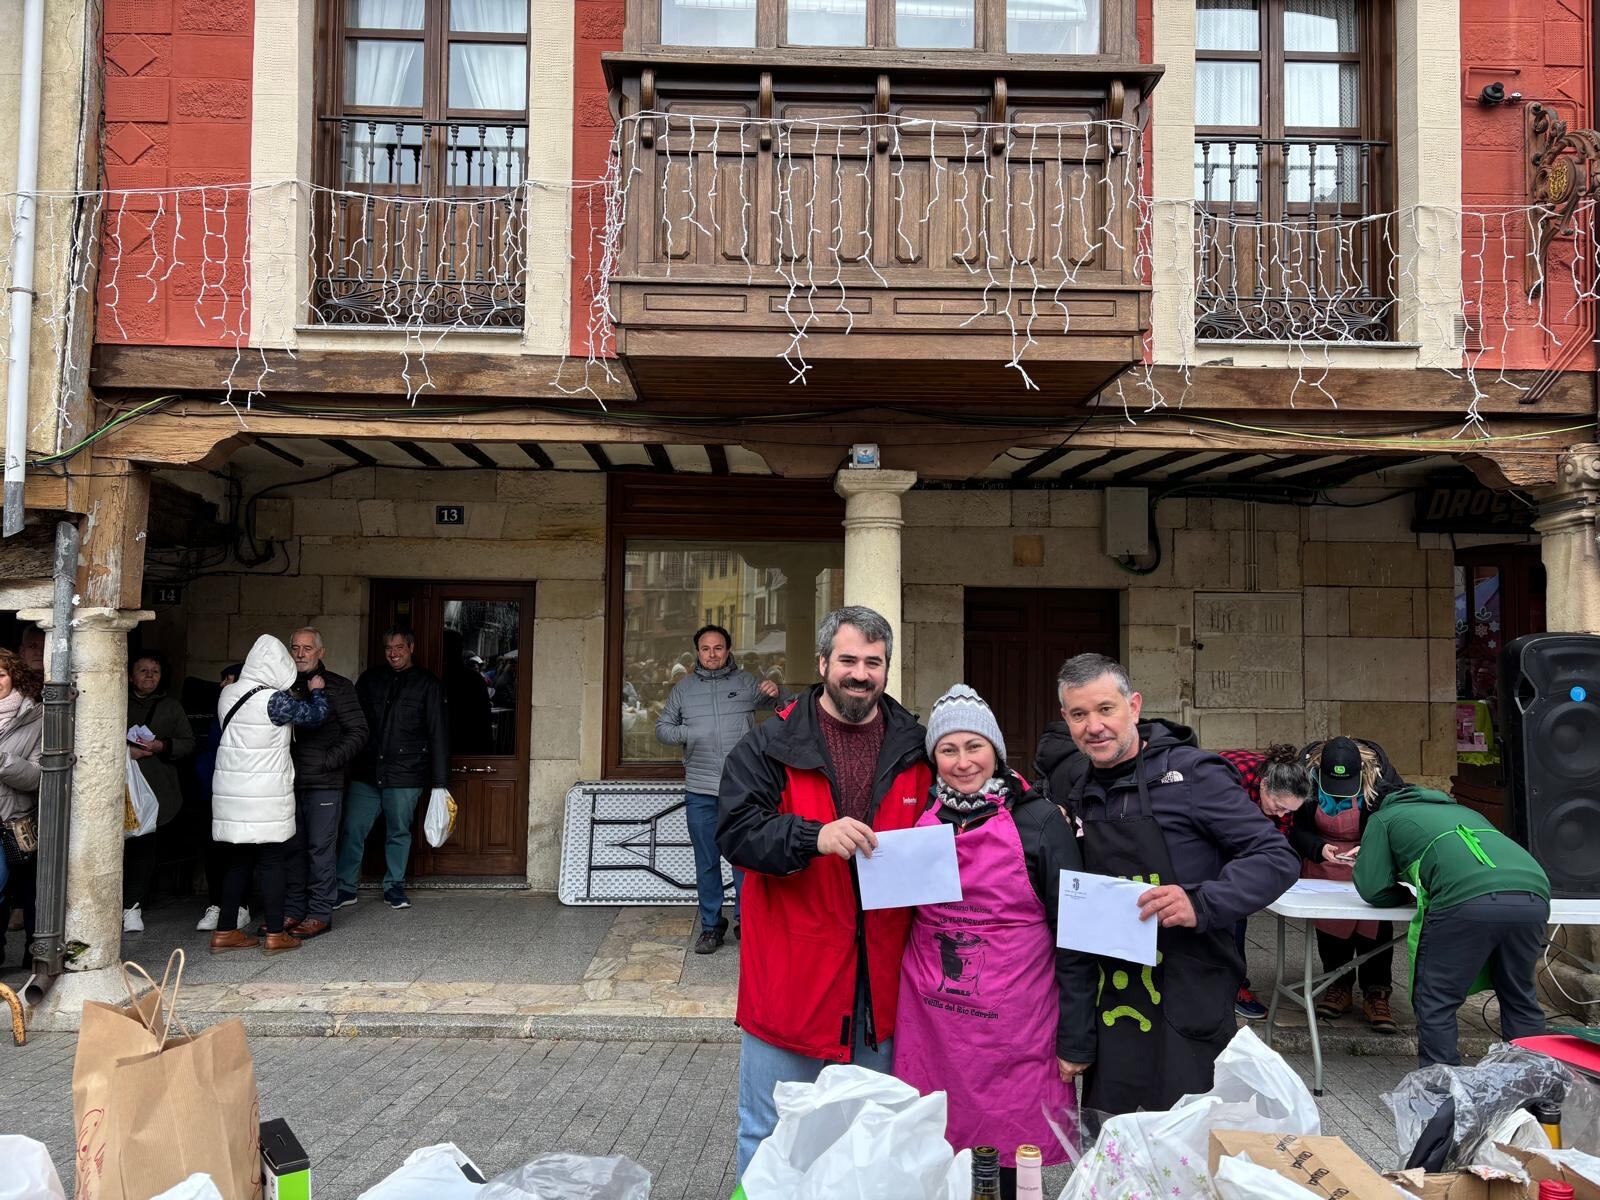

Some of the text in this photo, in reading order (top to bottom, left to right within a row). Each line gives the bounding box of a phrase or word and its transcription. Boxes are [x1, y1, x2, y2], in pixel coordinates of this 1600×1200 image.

[441, 509, 458, 522] 13
[159, 589, 177, 602] 14
[944, 1002, 955, 1012] del
